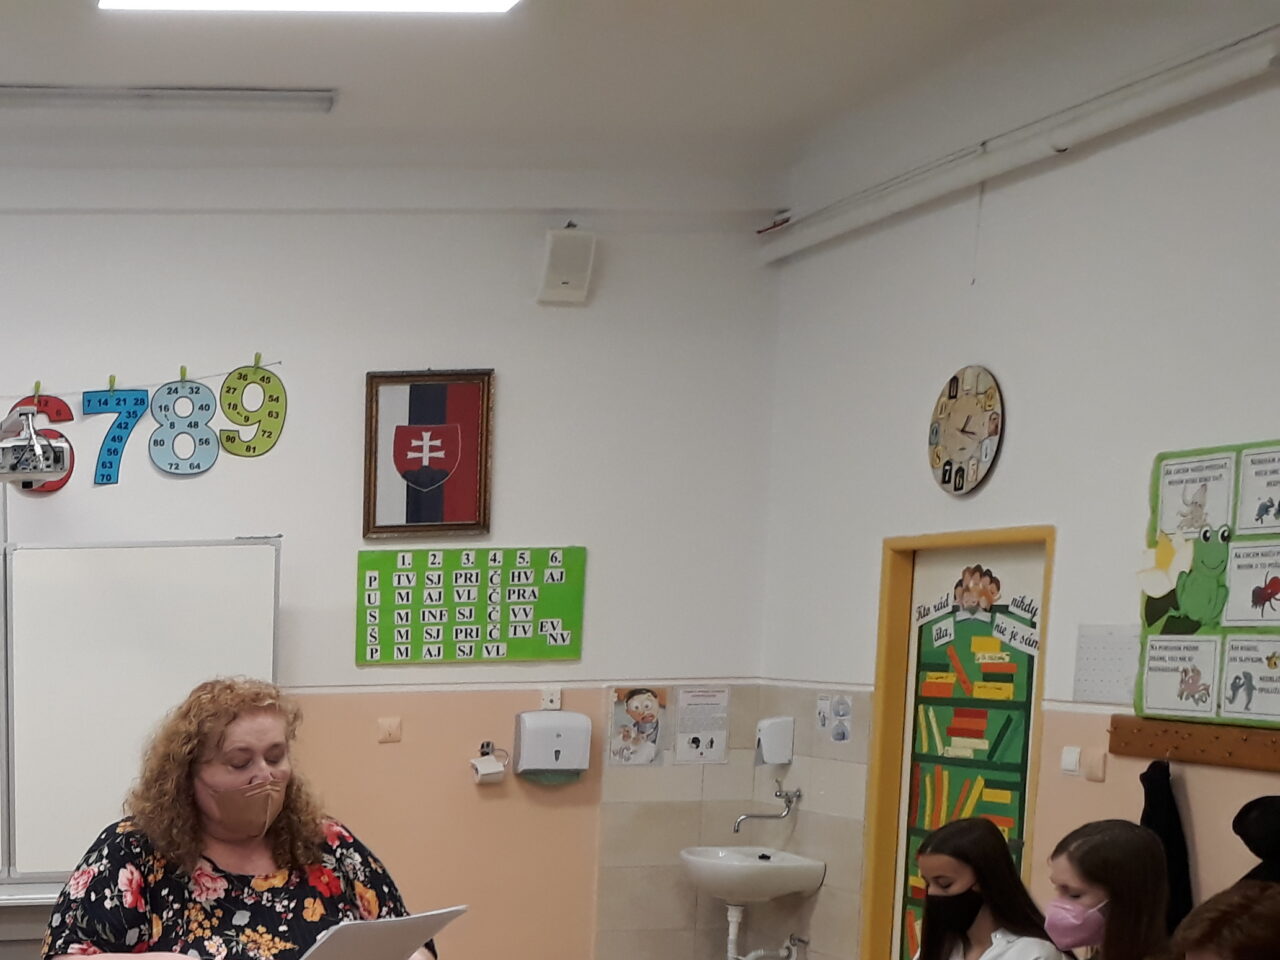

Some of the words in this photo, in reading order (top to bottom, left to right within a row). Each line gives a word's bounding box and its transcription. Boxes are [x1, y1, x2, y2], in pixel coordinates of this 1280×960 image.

[237, 373, 248, 382] 36
[259, 375, 271, 384] 45
[167, 387, 179, 395] 24
[188, 387, 200, 395] 32
[225, 386, 237, 395] 27
[98, 399, 108, 407] 14
[115, 398, 126, 406] 21
[134, 398, 145, 406] 28
[268, 394, 279, 403] 54
[158, 405, 169, 413] 16
[198, 403, 210, 412] 40
[227, 402, 237, 411] 18
[125, 410, 138, 419] 35
[267, 411, 279, 419] 63
[82, 389, 149, 484] 7
[148, 380, 220, 475] 8
[219, 365, 287, 457] 9
[117, 422, 129, 430] 42
[187, 421, 199, 429] 48
[111, 435, 123, 443] 49
[261, 430, 273, 439] 72
[153, 439, 165, 447] 80
[198, 438, 210, 446] 56
[225, 435, 236, 444] 90
[107, 448, 119, 456] 56
[245, 445, 256, 454] 81
[101, 461, 113, 469] 63
[168, 463, 180, 471] 72
[100, 474, 112, 482] 70
[401, 555, 410, 566] 1.
[430, 554, 441, 565] 2.
[463, 554, 474, 565] 3.
[490, 553, 501, 564] 4.
[518, 553, 529, 564] 5.
[551, 552, 561, 564] 6.
[368, 576, 377, 587] P
[395, 573, 415, 585] TV
[426, 574, 442, 585] SJ
[454, 573, 480, 584] PRI
[490, 570, 500, 585] Č
[511, 571, 533, 582] HV
[546, 571, 565, 583] AJ
[367, 593, 377, 605] U
[396, 592, 410, 603] M
[424, 592, 442, 603] AJ
[456, 590, 476, 601] VL
[488, 589, 500, 604] Č
[508, 589, 538, 600] PRA
[933, 593, 949, 613] rád
[1011, 595, 1038, 620] nikdy
[369, 611, 377, 622] S
[396, 612, 410, 623] M
[421, 610, 448, 621] INF
[458, 609, 473, 620] SJ
[488, 606, 499, 621] Č
[511, 608, 533, 619] VV
[369, 628, 378, 644] Š
[396, 630, 410, 641] M
[425, 629, 441, 640] SJ
[455, 628, 480, 639] PRI
[489, 625, 500, 640] Č
[510, 625, 532, 636] TV
[539, 621, 560, 632] EV
[994, 621, 1007, 636] nie
[1009, 625, 1017, 642] je
[549, 632, 570, 644] NV
[370, 648, 379, 659] P
[396, 647, 410, 658] M
[424, 647, 442, 658] AJ
[458, 645, 473, 657] SJ
[484, 645, 504, 656] VL
